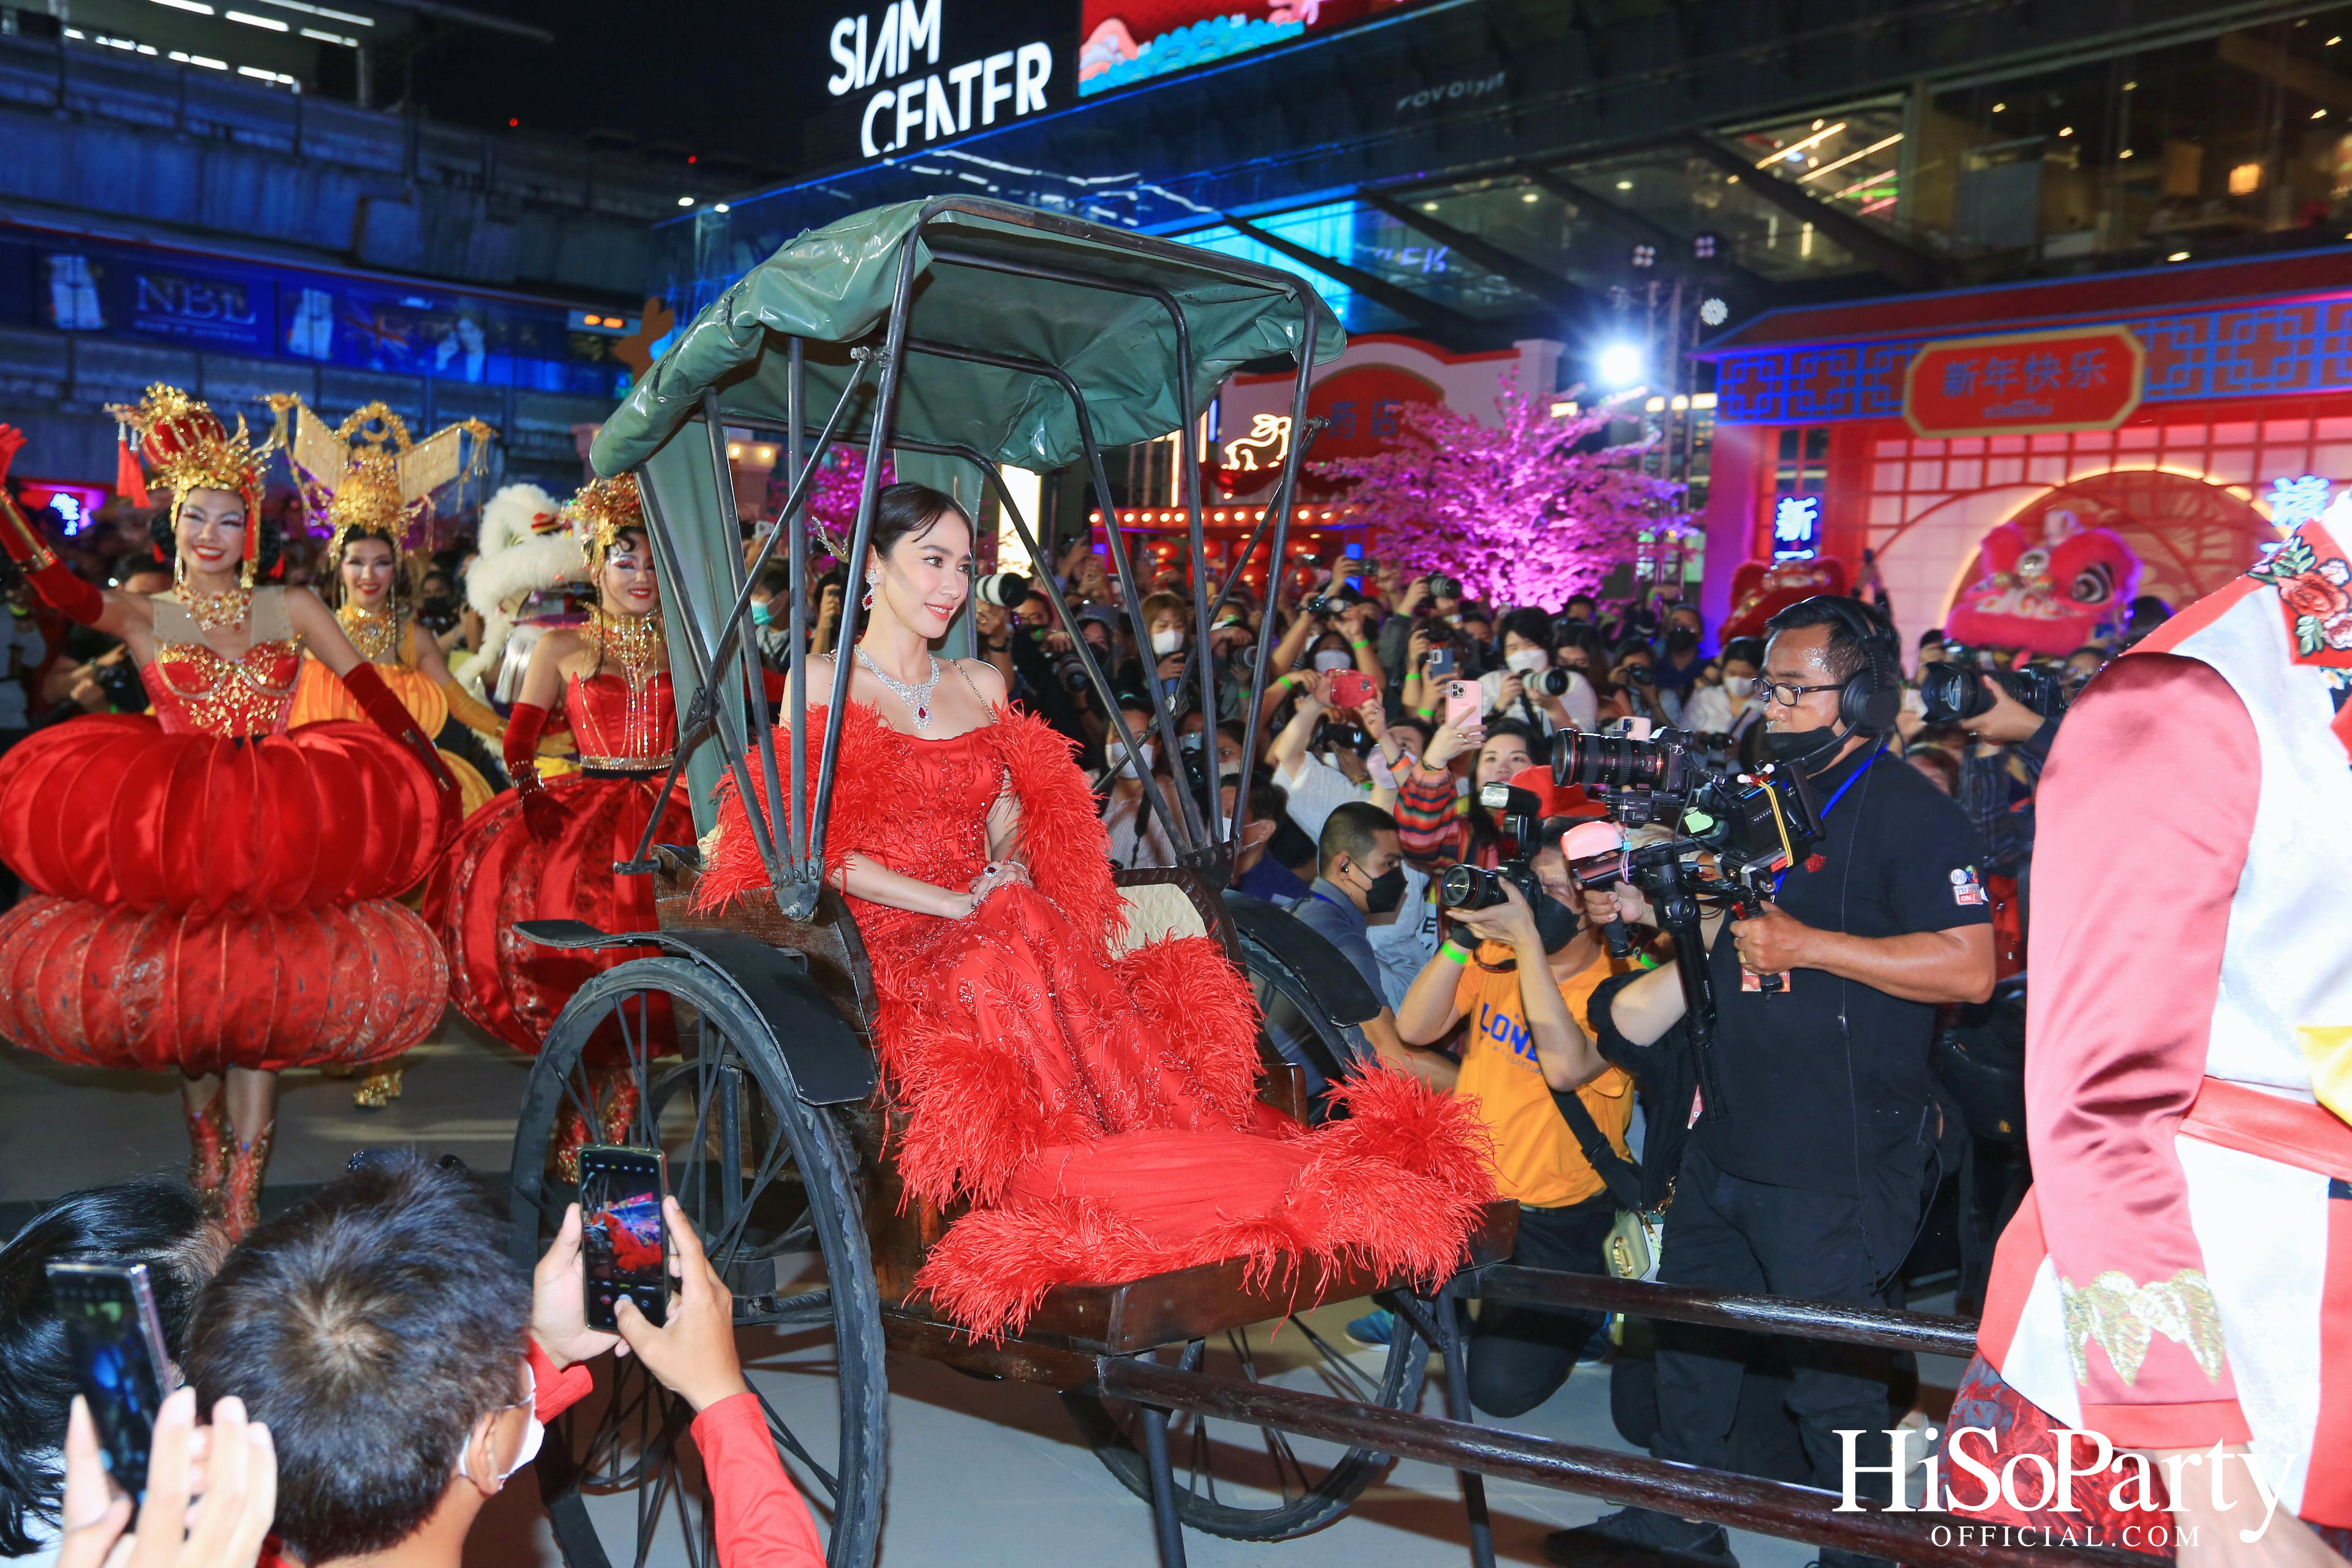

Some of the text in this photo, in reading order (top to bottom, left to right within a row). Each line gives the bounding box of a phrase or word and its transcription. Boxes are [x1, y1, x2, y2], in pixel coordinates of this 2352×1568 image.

[827, 0, 943, 96] SIAM
[1942, 348, 2107, 397] 新年快乐
